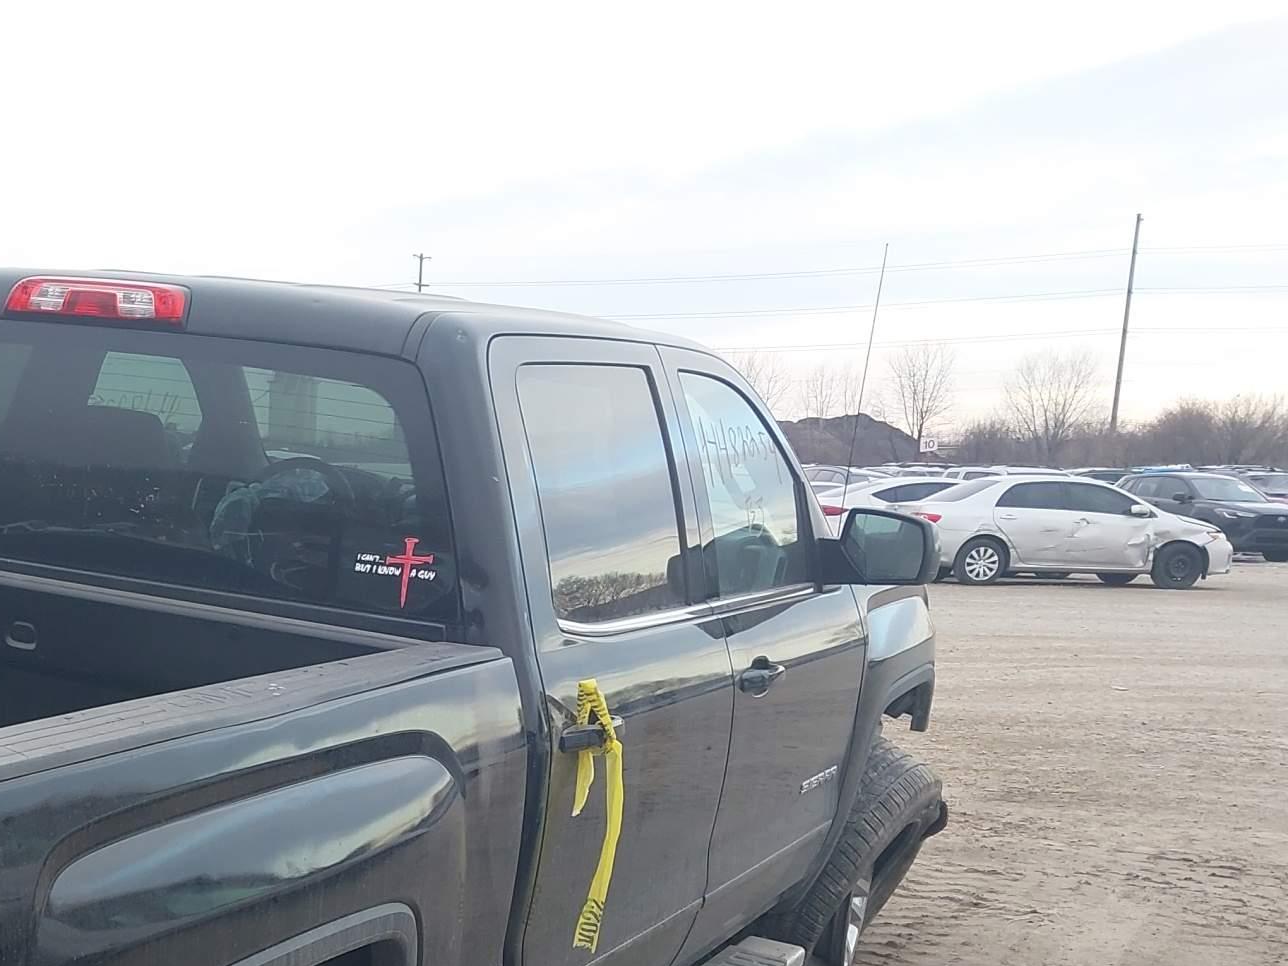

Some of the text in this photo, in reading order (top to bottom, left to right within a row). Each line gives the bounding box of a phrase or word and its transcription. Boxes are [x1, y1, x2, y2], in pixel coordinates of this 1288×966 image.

[923, 439, 935, 449] 10
[355, 562, 370, 573] BUT
[377, 565, 402, 577] KNOW
[409, 568, 417, 578] A
[418, 570, 436, 581] GUY
